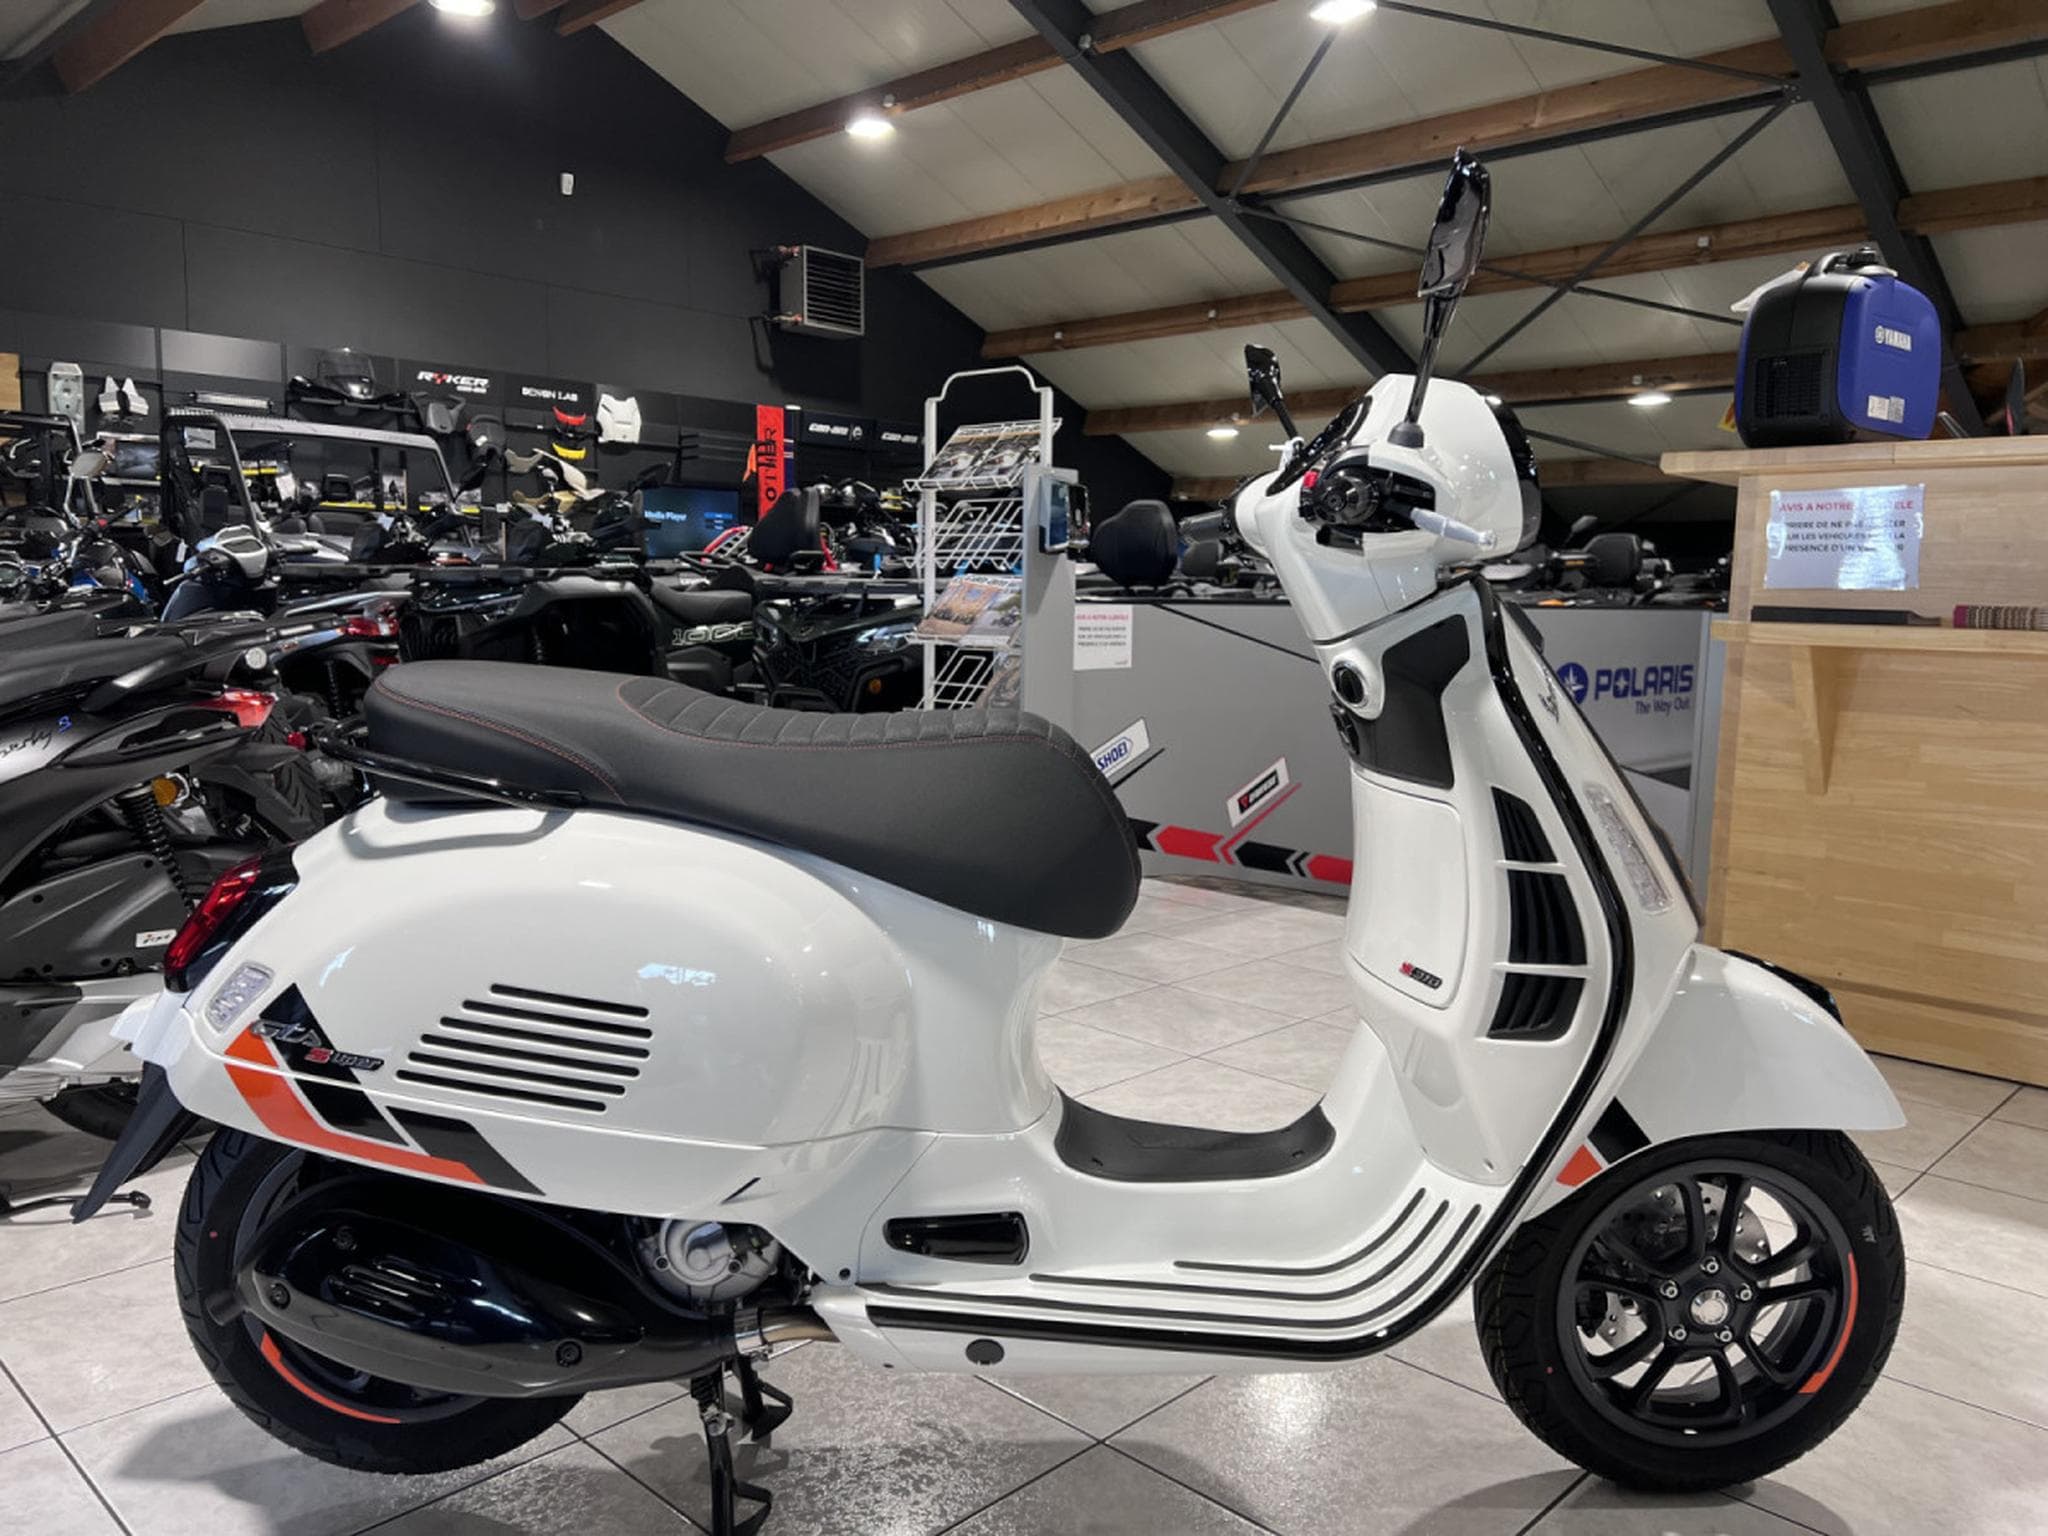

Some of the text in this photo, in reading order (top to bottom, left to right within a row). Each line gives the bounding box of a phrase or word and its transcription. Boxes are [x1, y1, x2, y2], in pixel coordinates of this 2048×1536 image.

[416, 371, 489, 388] RYKER
[1780, 501, 1803, 511] AVIS
[1595, 664, 1694, 701] POLARIS
[1636, 700, 1650, 715] The
[1653, 699, 1671, 716] Way
[1097, 741, 1128, 771] SHOEI
[304, 1047, 384, 1071] Super
